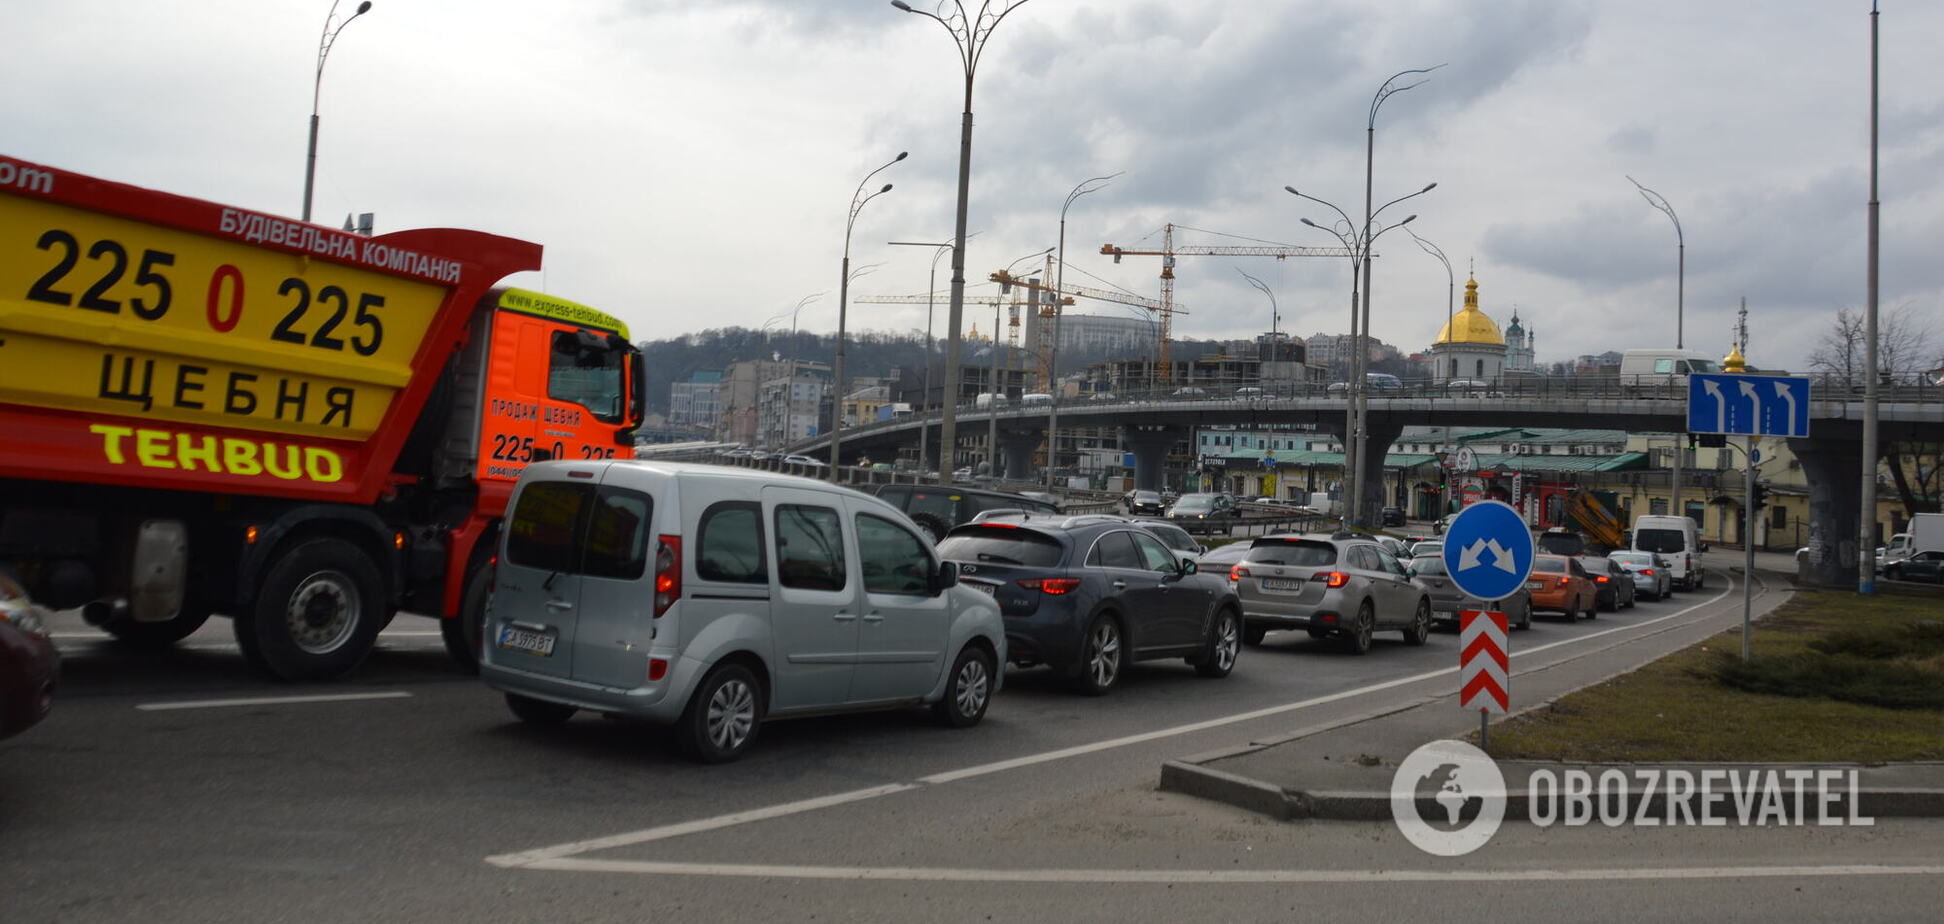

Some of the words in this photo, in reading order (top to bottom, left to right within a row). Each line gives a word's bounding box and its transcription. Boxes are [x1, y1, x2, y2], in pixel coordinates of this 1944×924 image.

[220, 208, 357, 262] БУДІВЕЛЬНА
[361, 242, 462, 284] КОМПАНІЯ
[26, 229, 175, 322] 225
[206, 264, 246, 333] 0
[271, 277, 386, 357] 225
[99, 353, 356, 428] ЩЕБНЯ
[491, 399, 539, 421] ПРОДАЖ
[544, 407, 582, 427] ЩЕБНЯ
[90, 425, 344, 483] TEHBUD
[492, 434, 534, 463] 225
